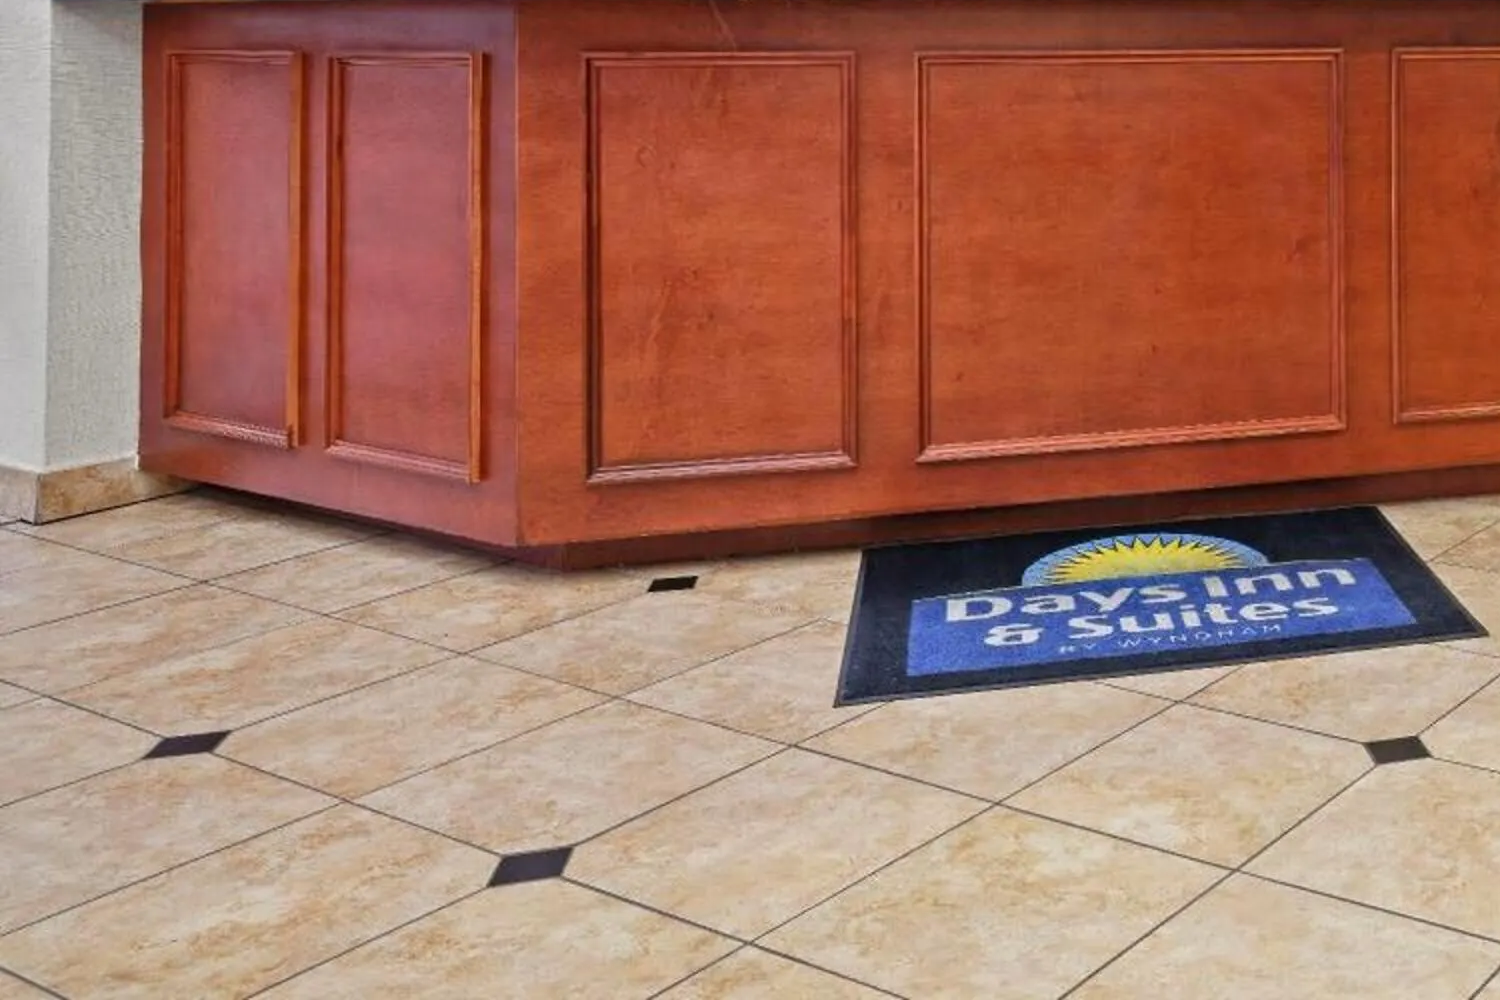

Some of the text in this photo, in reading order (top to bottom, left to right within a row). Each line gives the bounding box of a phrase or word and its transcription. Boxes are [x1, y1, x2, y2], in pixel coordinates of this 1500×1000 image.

[945, 567, 1357, 623] Days Inn
[983, 596, 1340, 647] & Suites
[1117, 624, 1282, 648] WYNDHAM
